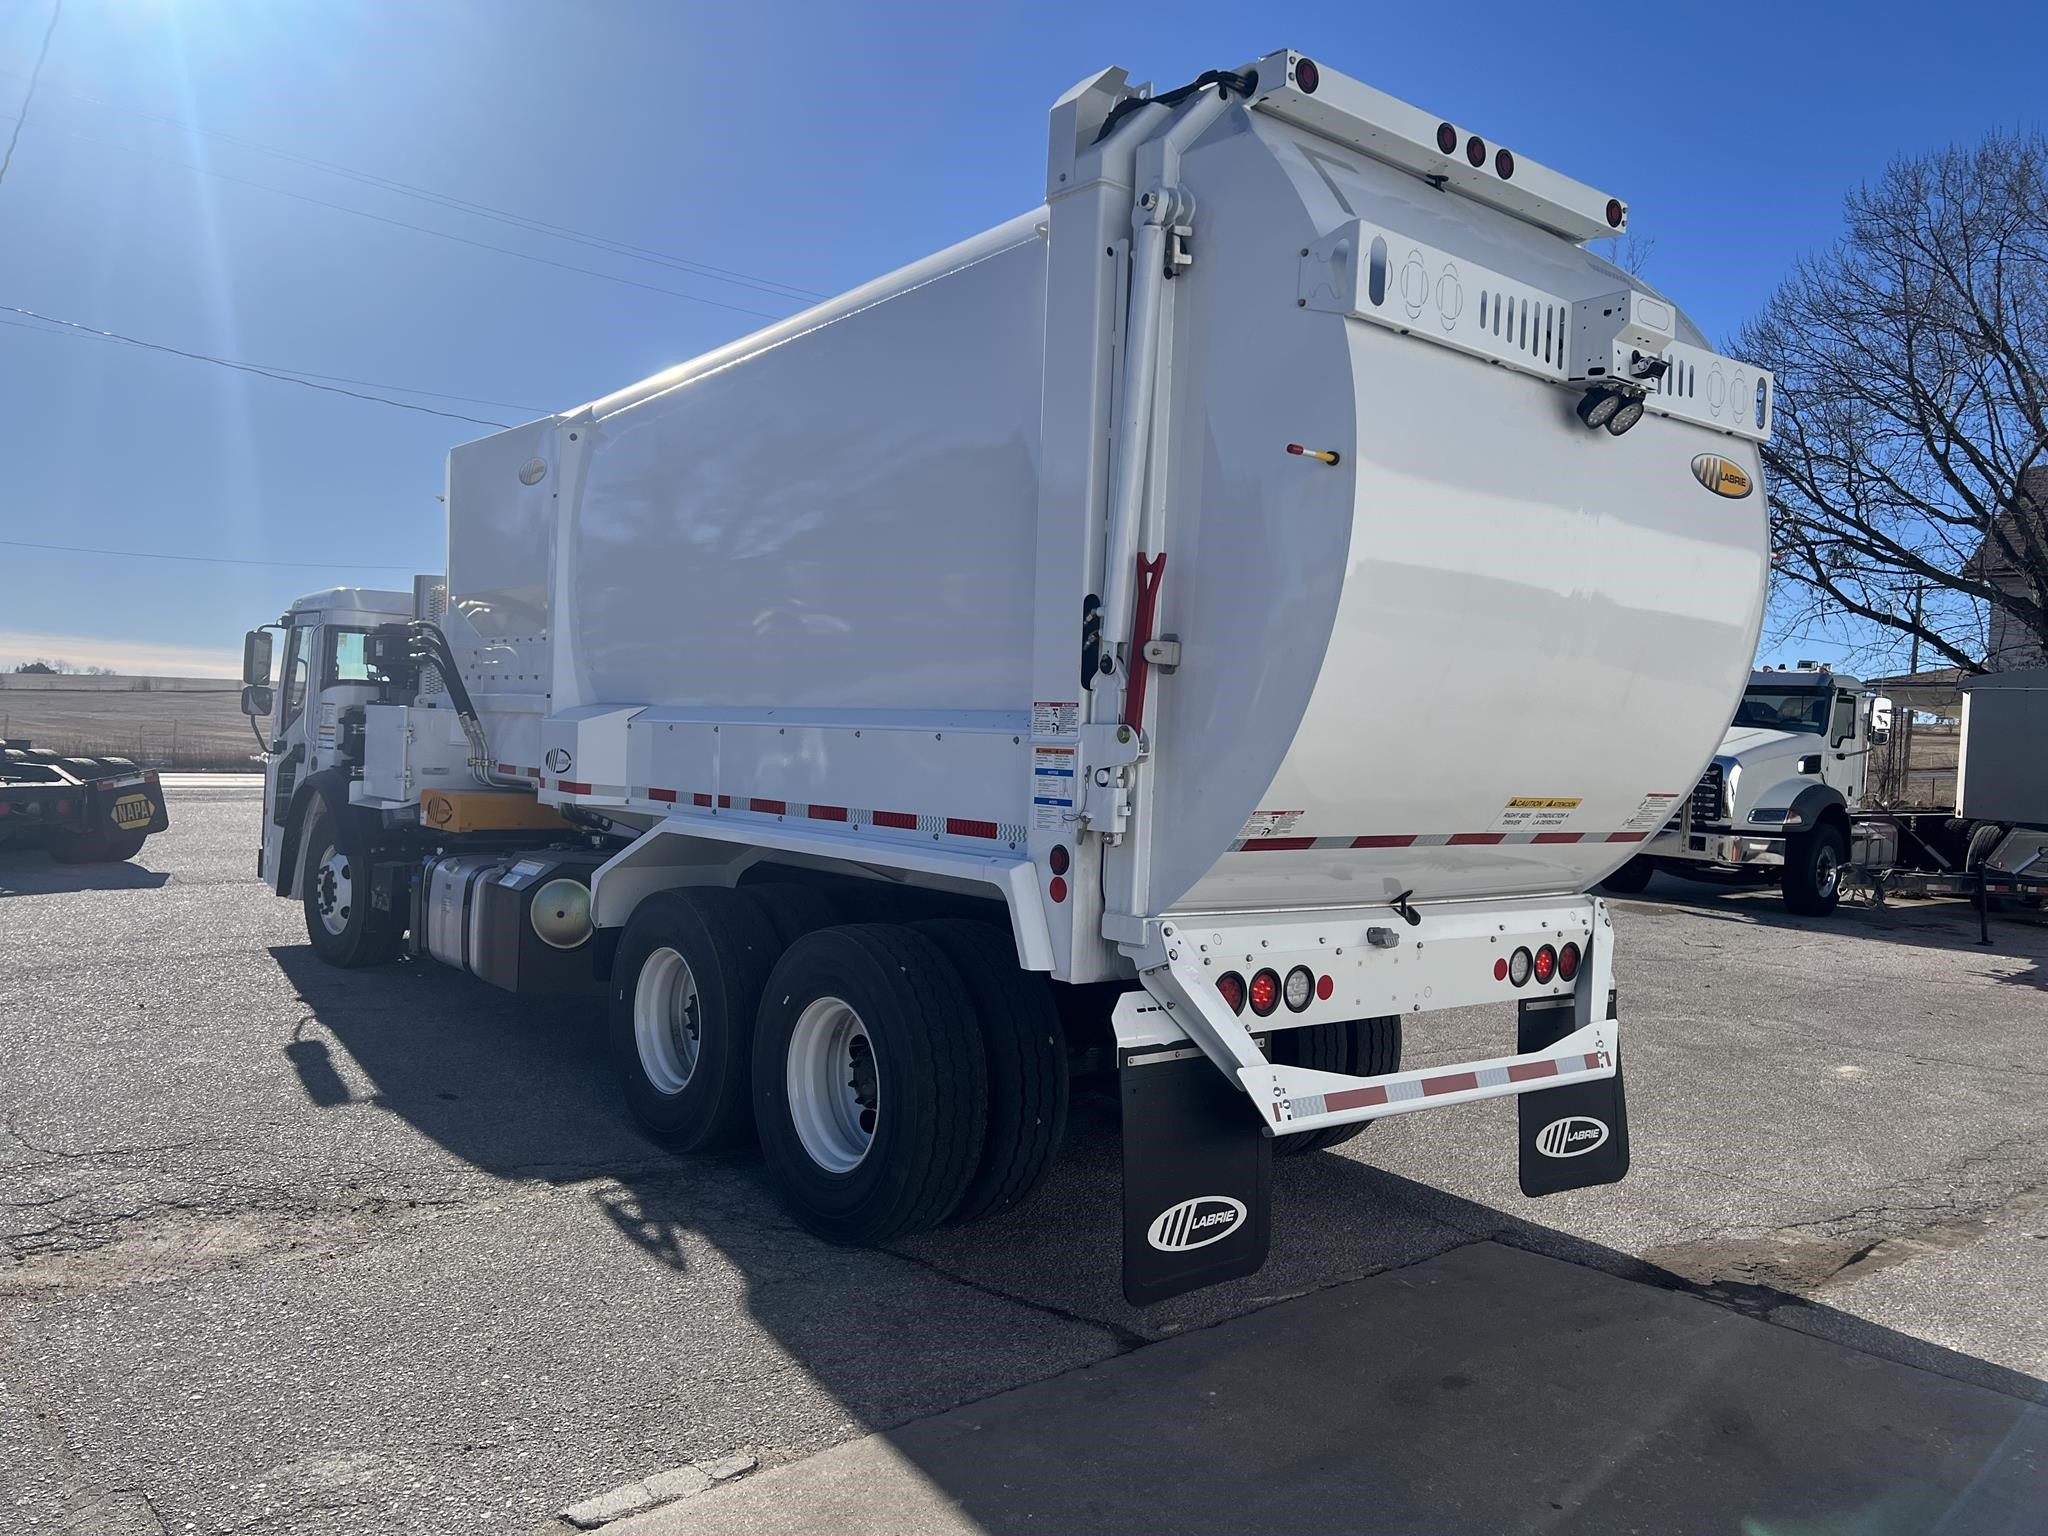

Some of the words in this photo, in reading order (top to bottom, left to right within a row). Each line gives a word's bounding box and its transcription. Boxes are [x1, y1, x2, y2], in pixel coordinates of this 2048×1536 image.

[1720, 471, 1746, 487] LABRIE
[118, 800, 150, 822] NAPA
[1568, 1128, 1600, 1142] LABRIE
[1192, 1209, 1236, 1230] LABRIE
